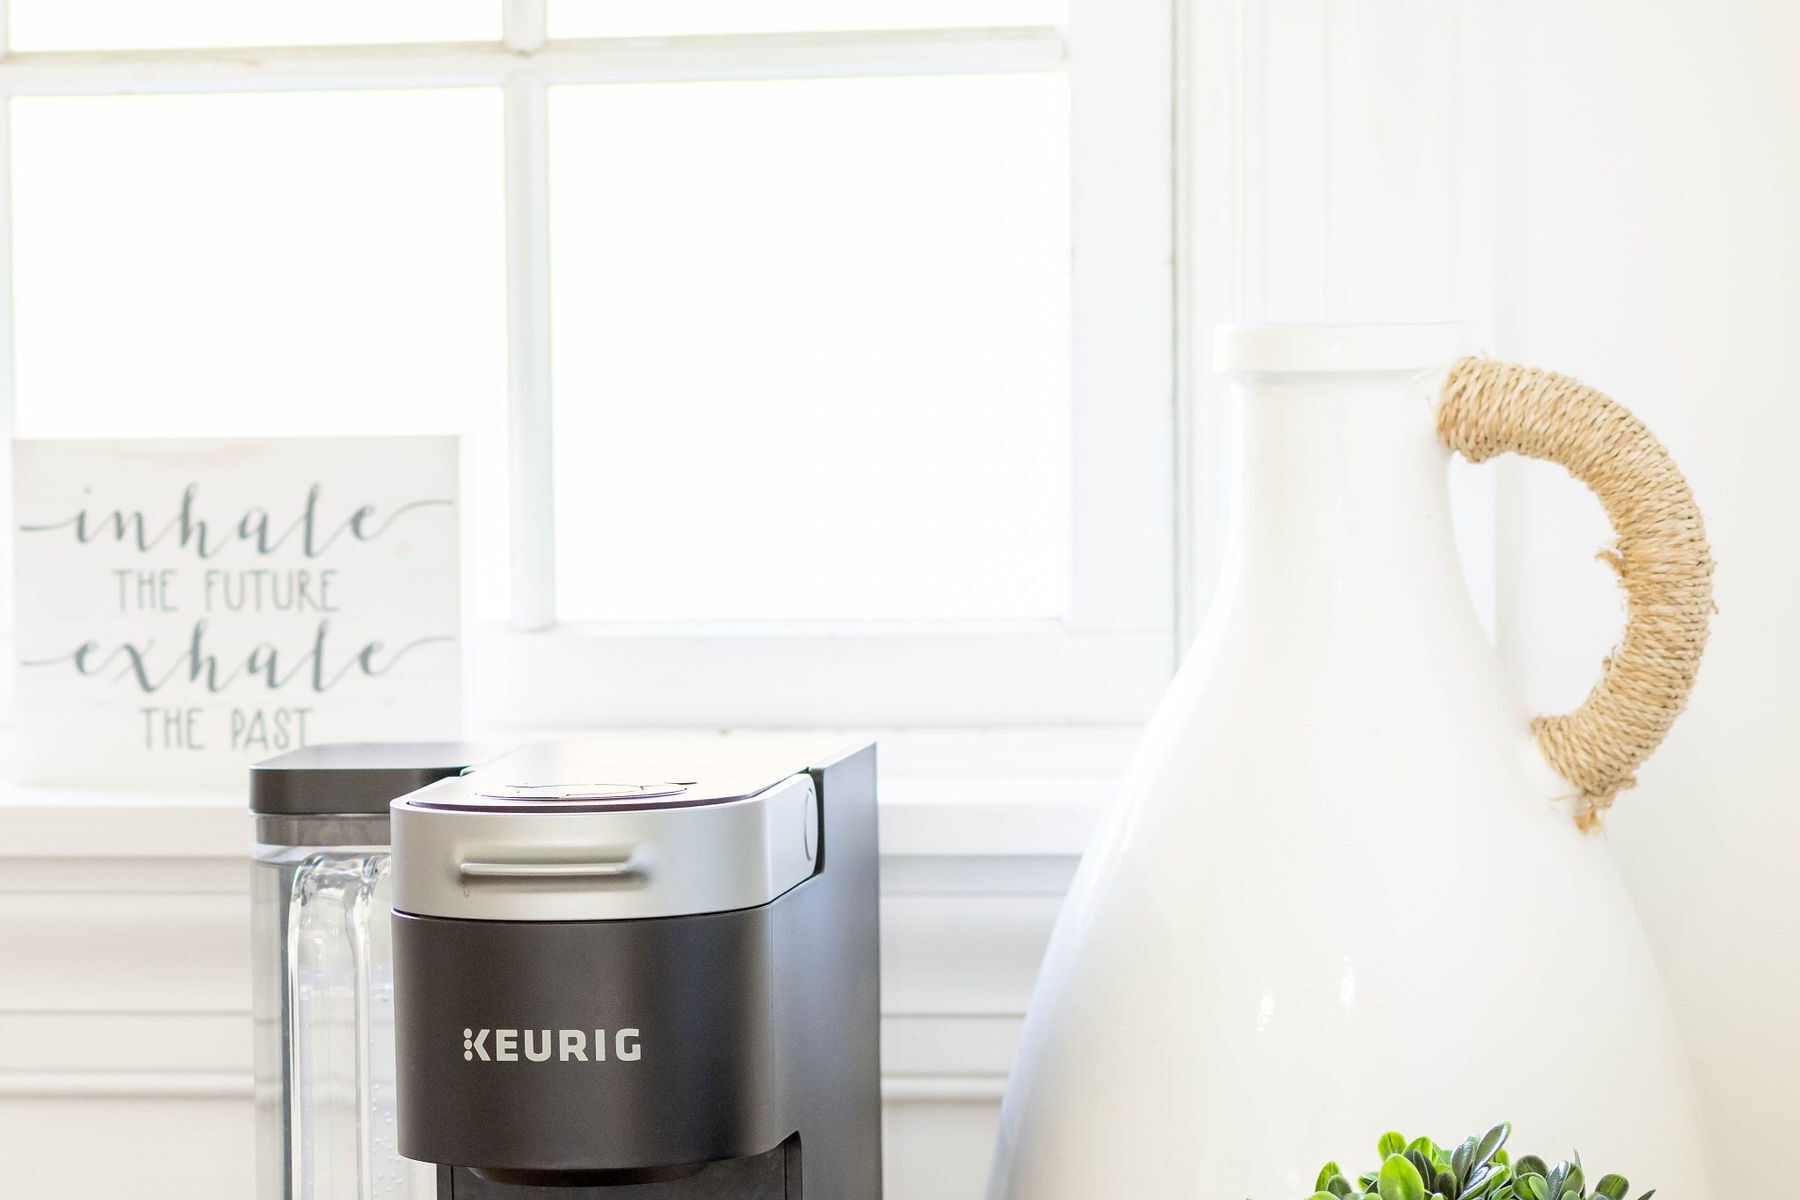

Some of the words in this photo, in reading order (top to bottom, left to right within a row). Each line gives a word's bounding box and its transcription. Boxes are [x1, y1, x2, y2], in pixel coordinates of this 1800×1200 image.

[19, 481, 455, 559] inhale
[114, 569, 178, 612] THE
[204, 569, 339, 612] FUTURE
[21, 617, 457, 692] exhale
[139, 707, 205, 751] THE
[230, 707, 315, 751] PAST
[463, 1027, 642, 1062] KEURIG
